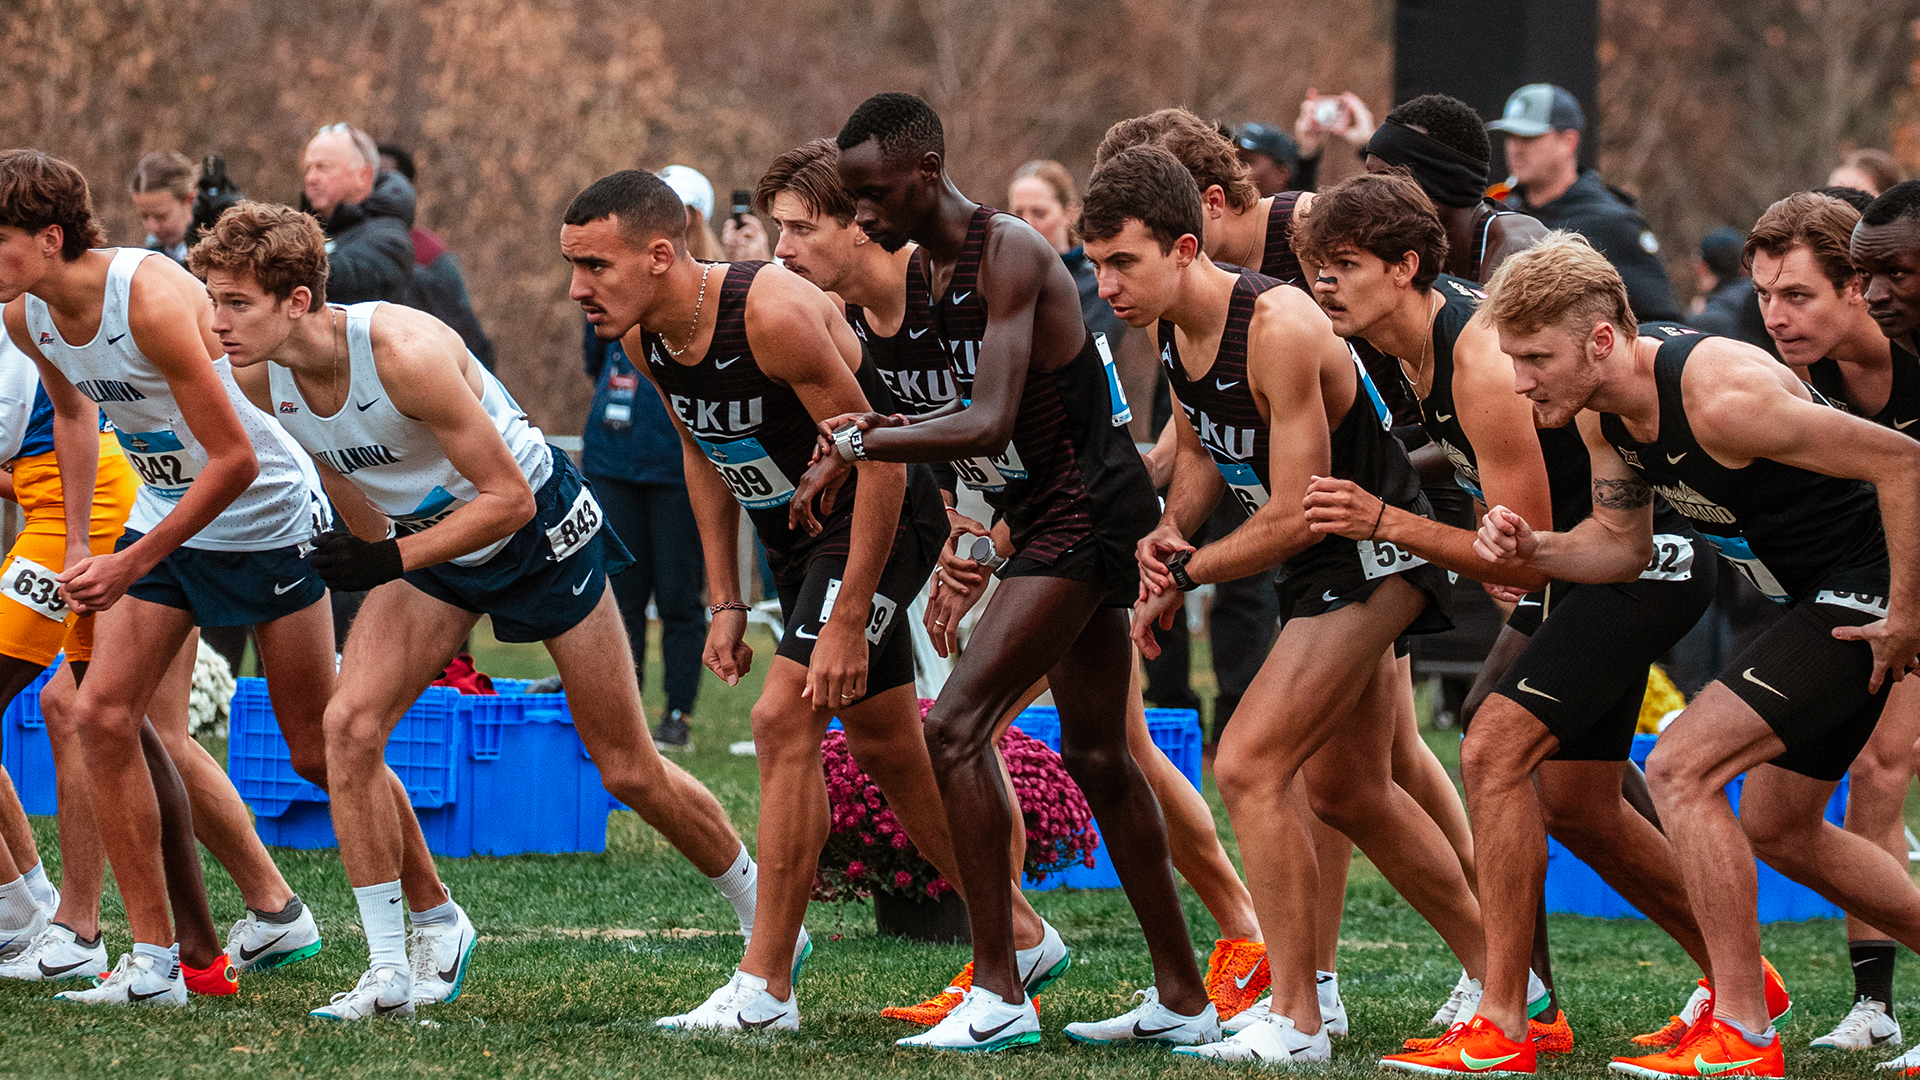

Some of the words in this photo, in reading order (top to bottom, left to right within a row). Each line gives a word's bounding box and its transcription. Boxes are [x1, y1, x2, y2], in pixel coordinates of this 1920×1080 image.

[670, 393, 763, 432] EKU
[130, 453, 194, 486] 842
[313, 444, 403, 475] ILLANOVA
[560, 500, 598, 548] 843
[13, 568, 66, 613] 639
